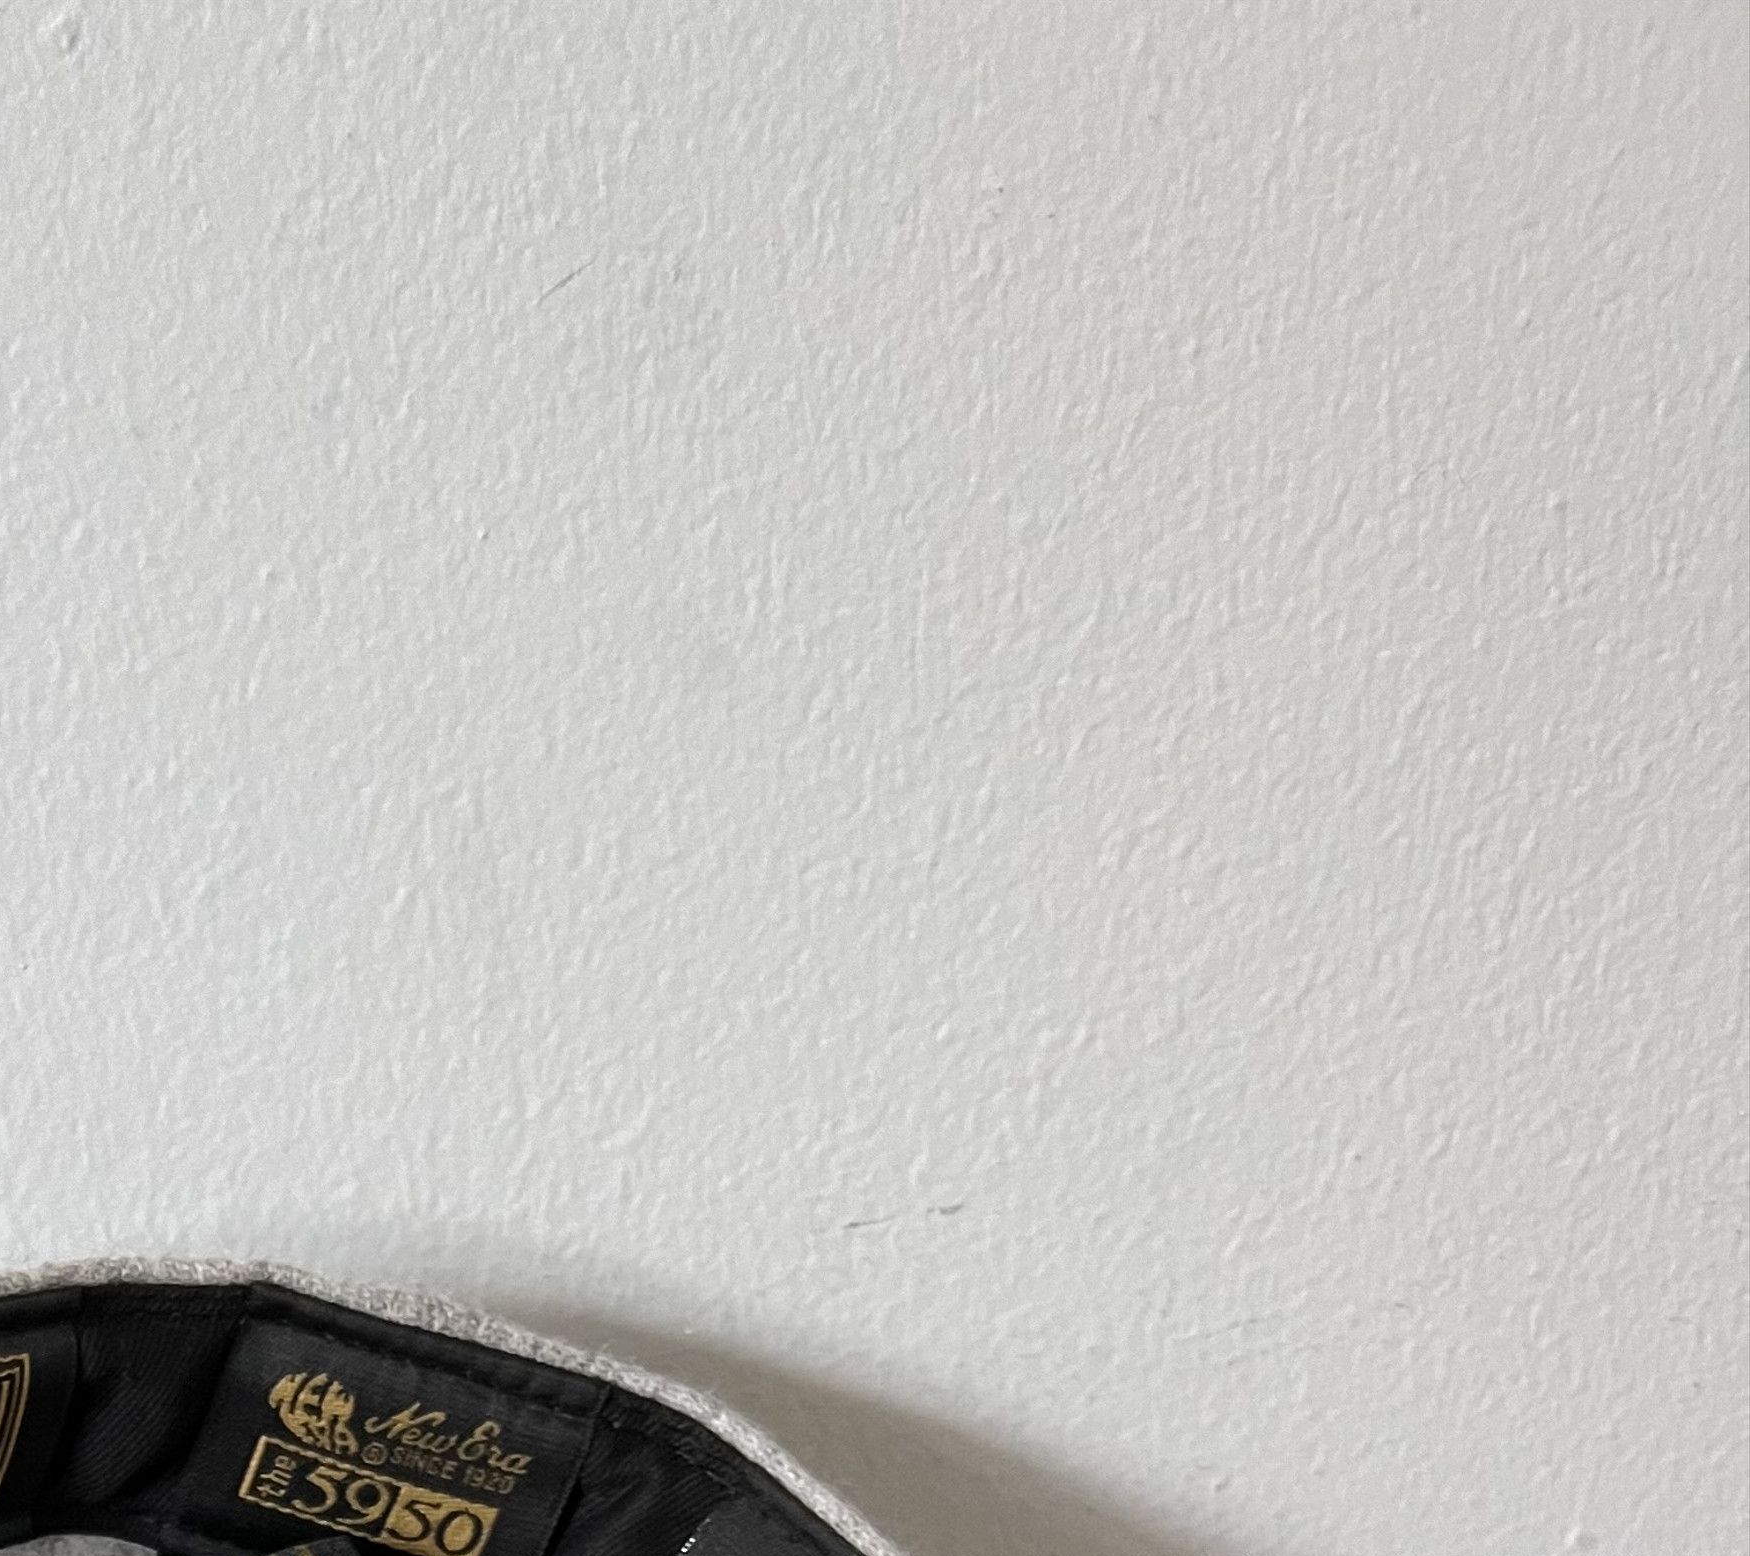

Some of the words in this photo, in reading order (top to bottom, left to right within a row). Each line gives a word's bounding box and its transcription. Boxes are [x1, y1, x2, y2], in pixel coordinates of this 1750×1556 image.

[365, 1401, 458, 1454] New
[457, 1420, 532, 1474] Era
[257, 1453, 297, 1499] the
[390, 1447, 458, 1481] SINCE
[464, 1464, 515, 1495] 1920
